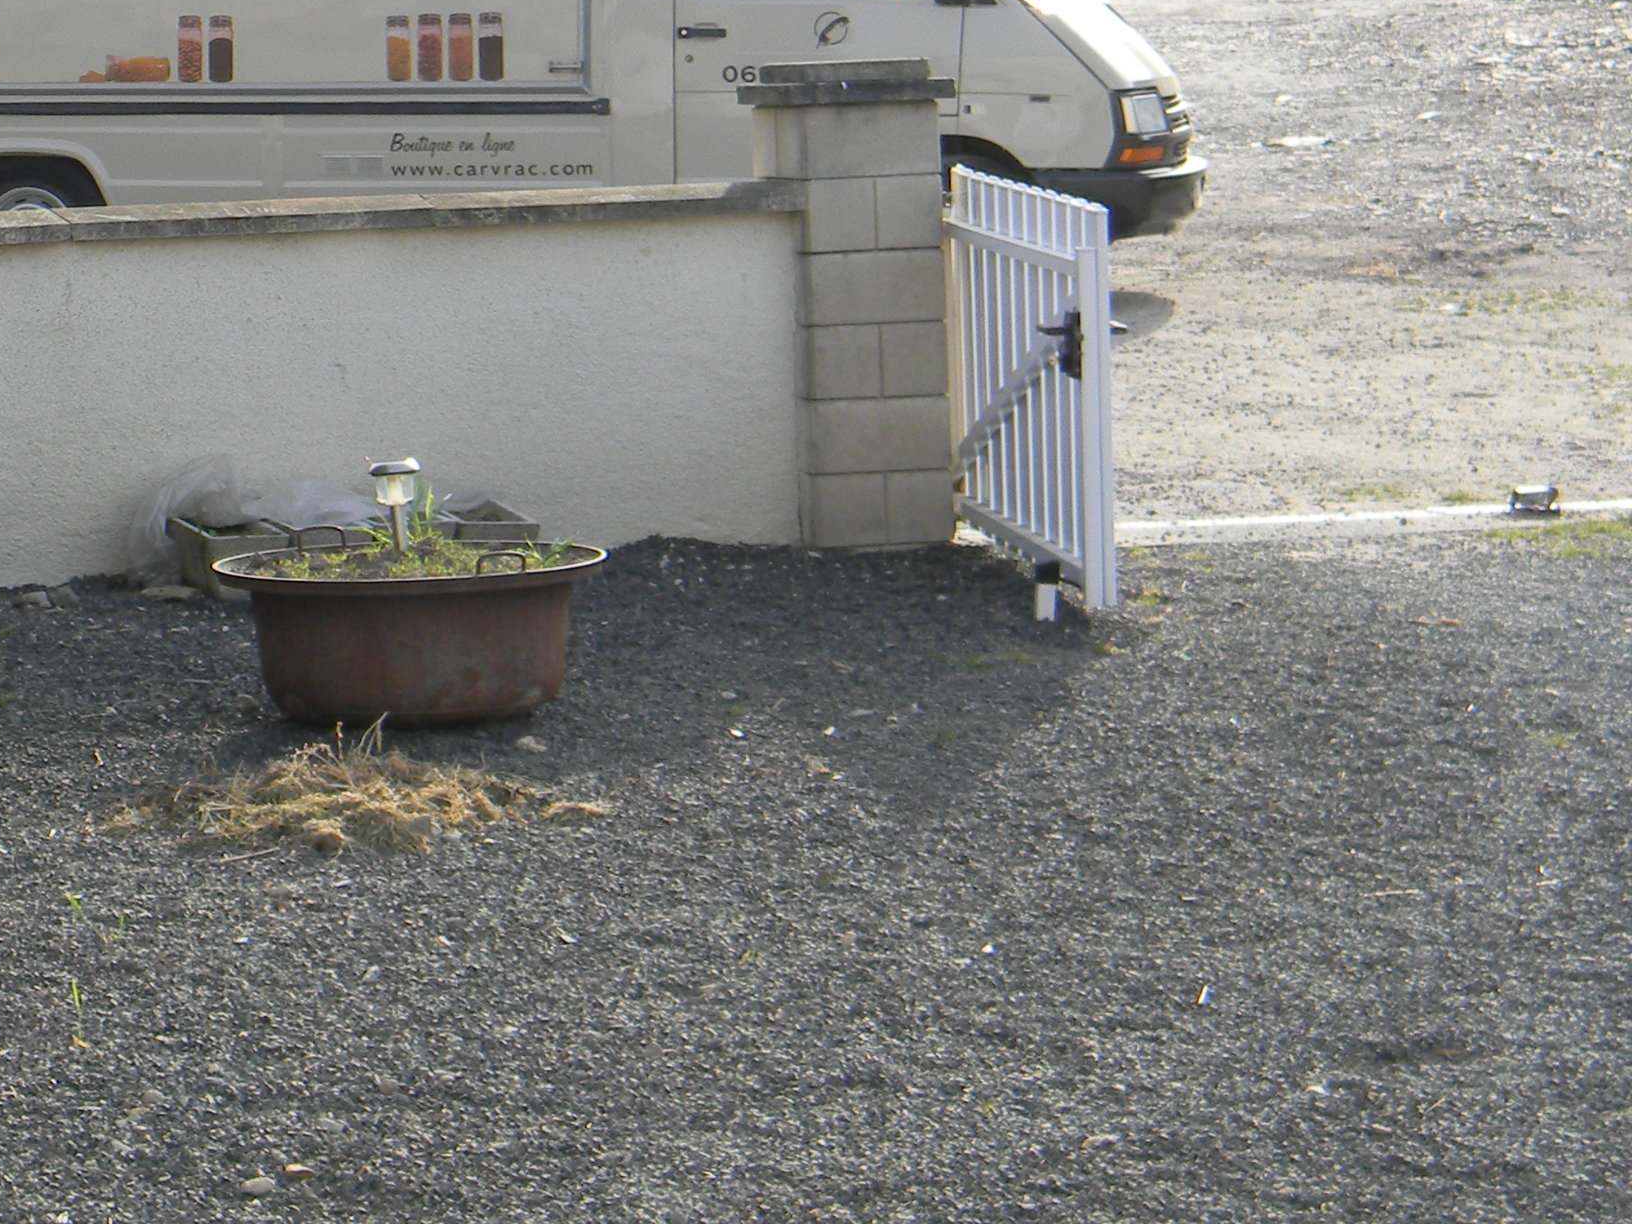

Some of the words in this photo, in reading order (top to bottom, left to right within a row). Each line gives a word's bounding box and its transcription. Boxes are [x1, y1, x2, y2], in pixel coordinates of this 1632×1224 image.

[722, 65, 757, 84] 06
[389, 132, 454, 158] Boutique
[458, 139, 477, 152] en
[481, 132, 516, 158] ligne
[391, 163, 594, 176] www.carvrac.com
